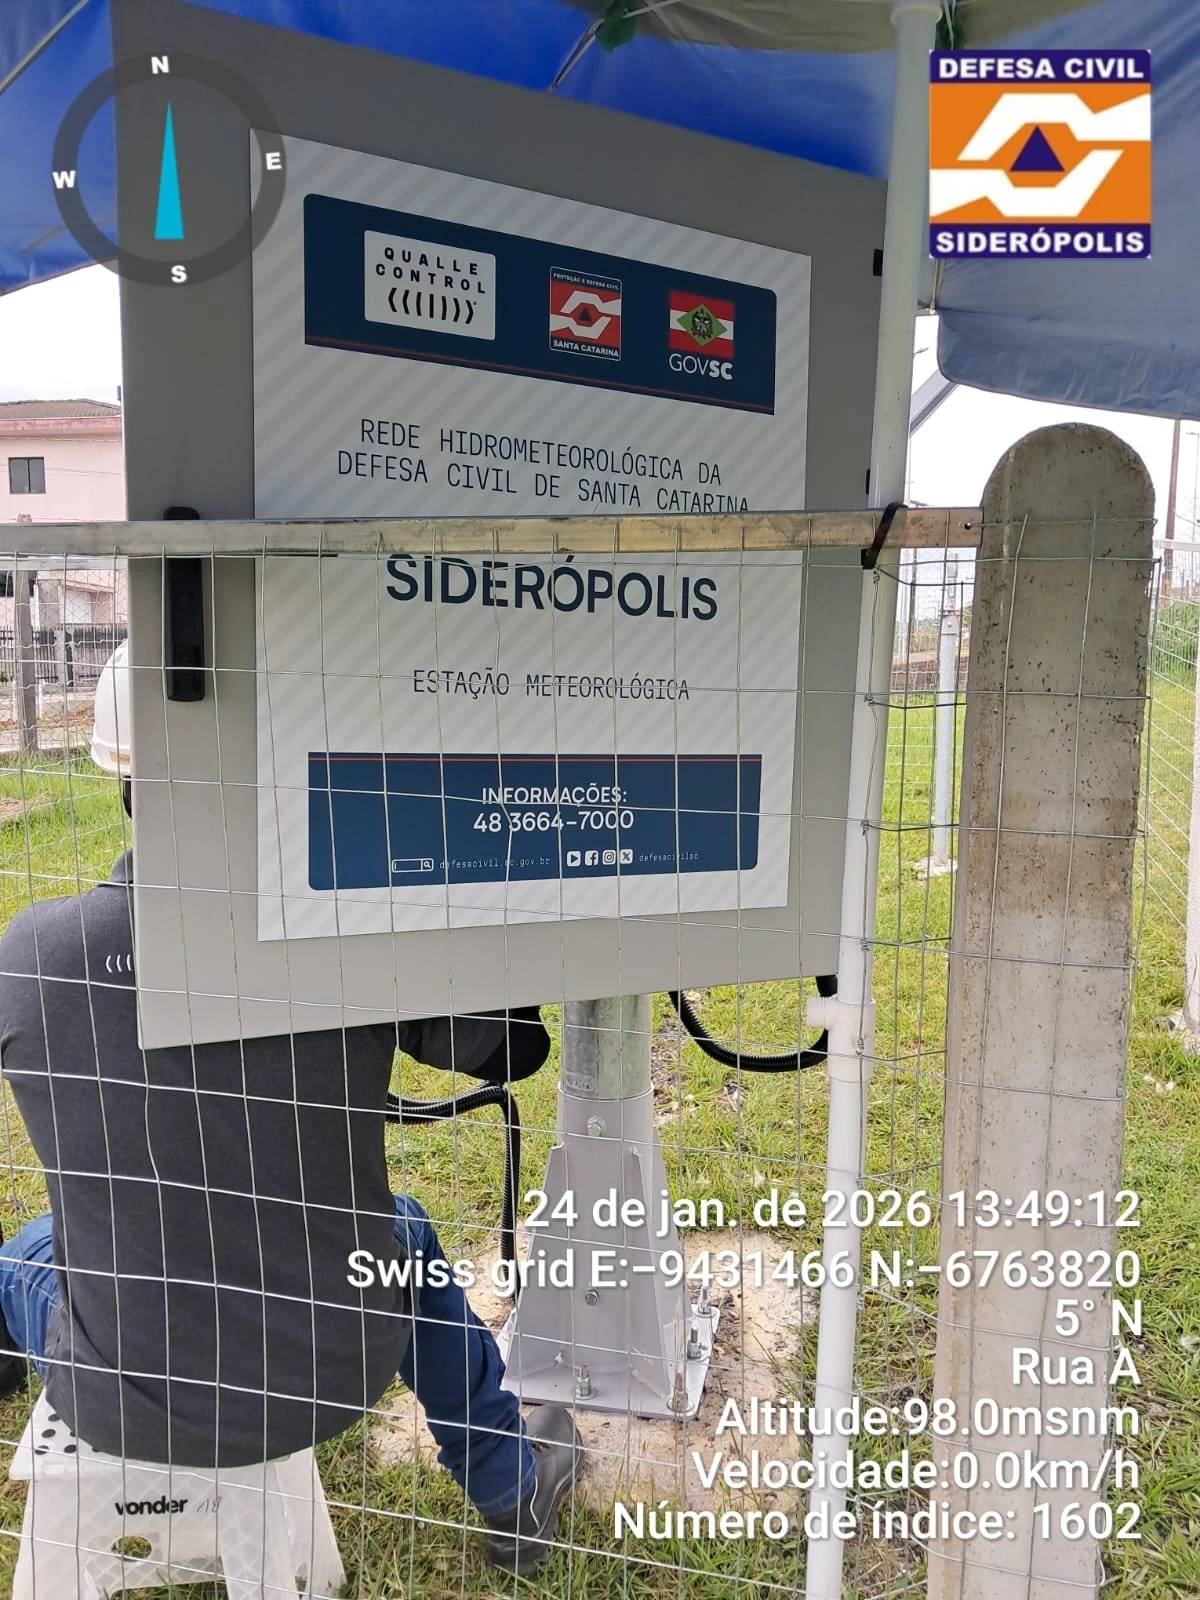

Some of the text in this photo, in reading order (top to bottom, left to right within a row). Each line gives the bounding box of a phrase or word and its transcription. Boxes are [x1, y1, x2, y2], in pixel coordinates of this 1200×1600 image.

[384, 247, 478, 275] QUALLE
[376, 263, 485, 294] CONTROL
[553, 340, 619, 357] SANTA CATARINA
[669, 353, 734, 380] GOVSC
[361, 418, 721, 486] REDE HIDROMETEOROLÓGICA DA
[338, 450, 748, 513] DEFESA CIVIL DE SANTA CATARINA
[386, 553, 718, 621] SIDERÓPOLIS
[413, 667, 690, 700] ESTAÇÃO METEOROLÓGICA
[482, 782, 627, 807] INFORMAÇÕES:
[473, 810, 634, 832] 48 3664-7000
[639, 851, 699, 862] defesaciilsc
[115, 1495, 188, 1515] vonder
